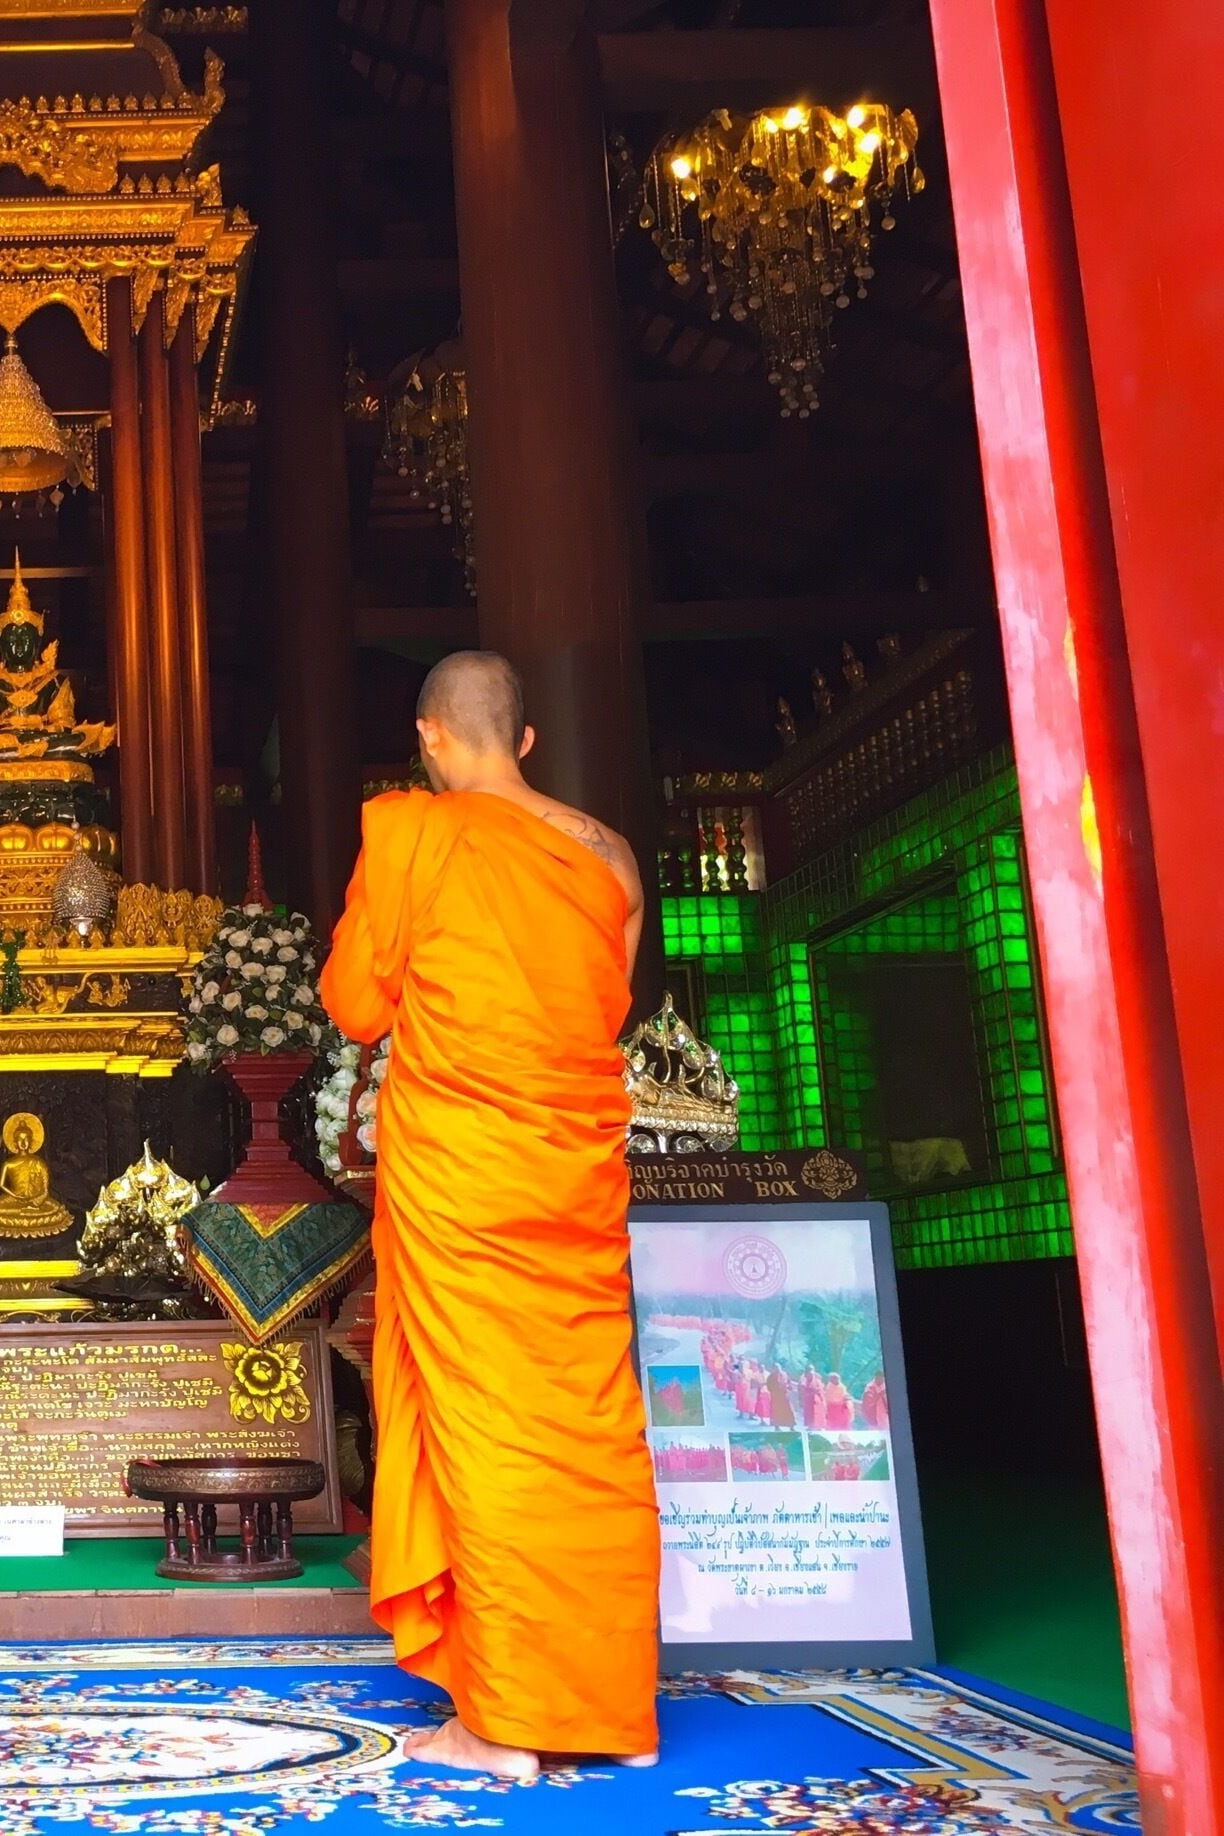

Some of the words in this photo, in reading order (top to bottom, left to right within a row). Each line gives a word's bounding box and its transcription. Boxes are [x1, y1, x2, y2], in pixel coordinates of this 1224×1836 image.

[625, 1154, 788, 1183] ิญบริจาคบำรุงวัด
[632, 1182, 725, 1200] ONATION
[755, 1181, 799, 1198] BOX
